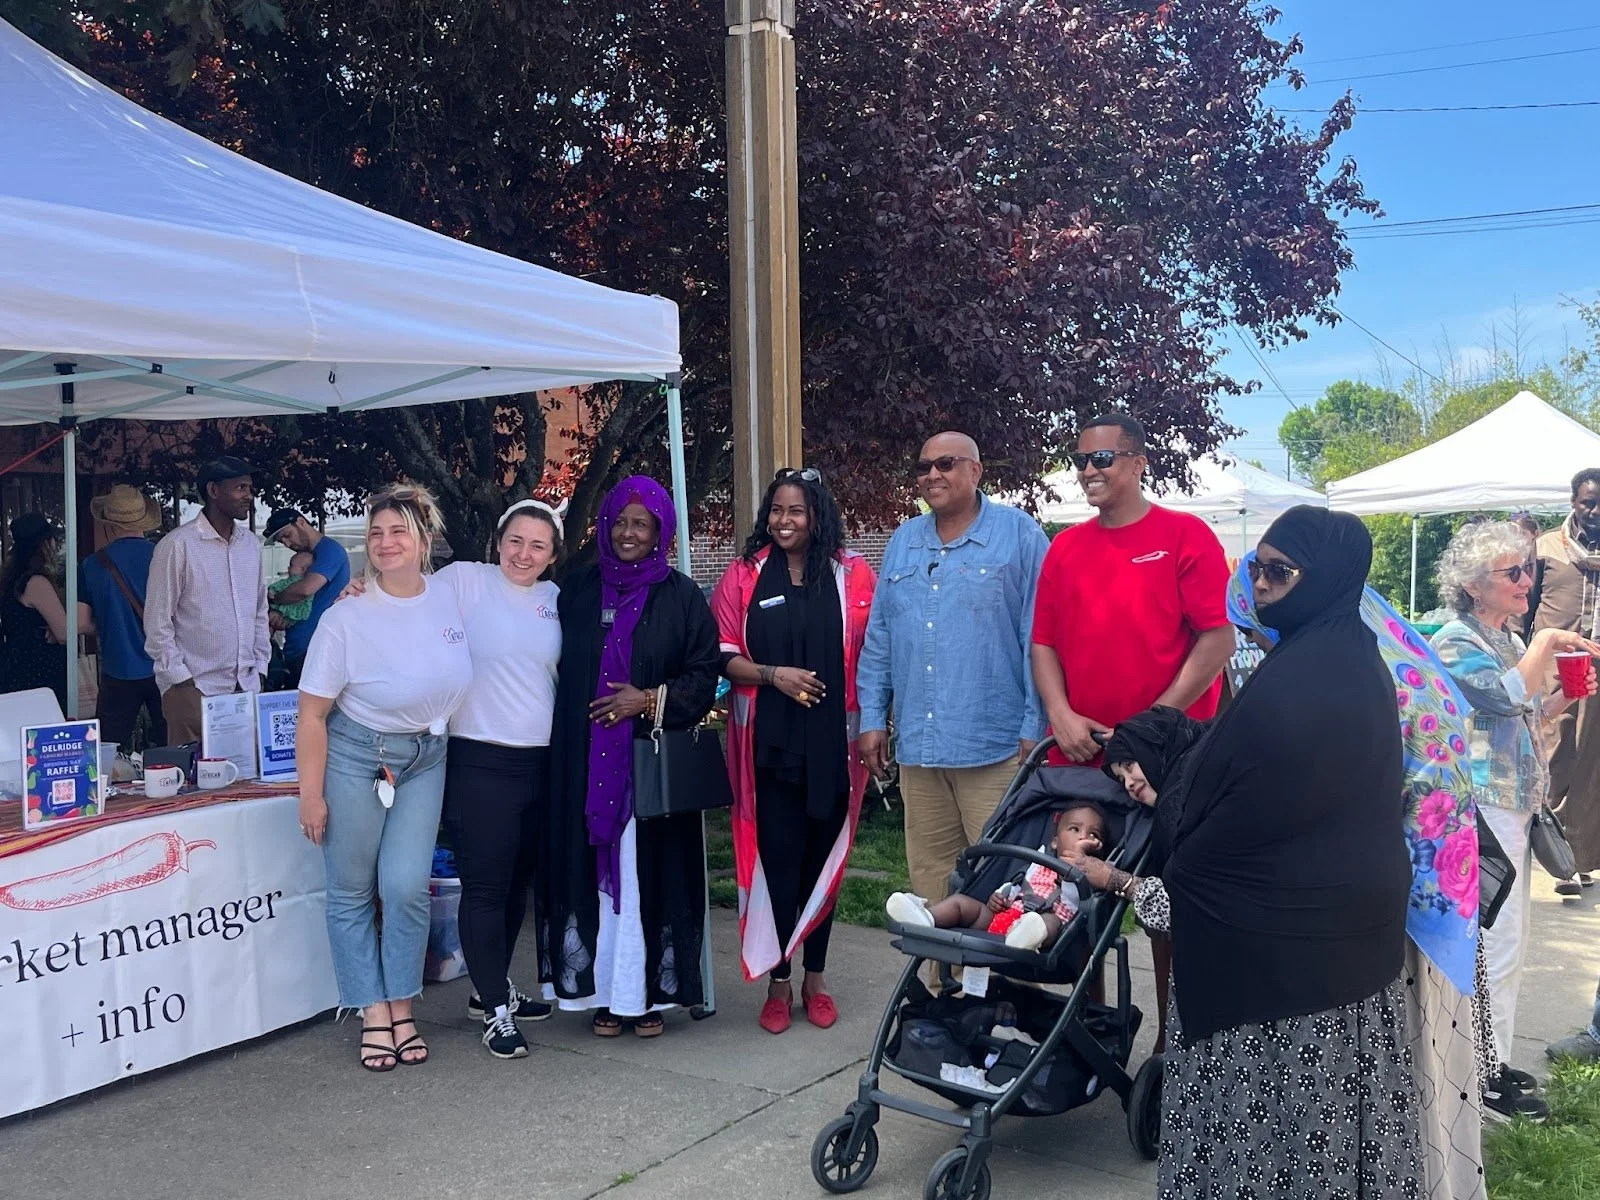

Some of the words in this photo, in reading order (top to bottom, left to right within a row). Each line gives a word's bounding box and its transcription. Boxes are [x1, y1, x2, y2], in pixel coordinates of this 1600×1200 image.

[42, 742, 82, 753] DELRIDGE
[271, 751, 292, 760] DONATE
[46, 765, 79, 776] RAFFLE
[98, 890, 282, 961] manager
[96, 986, 186, 1044] info
